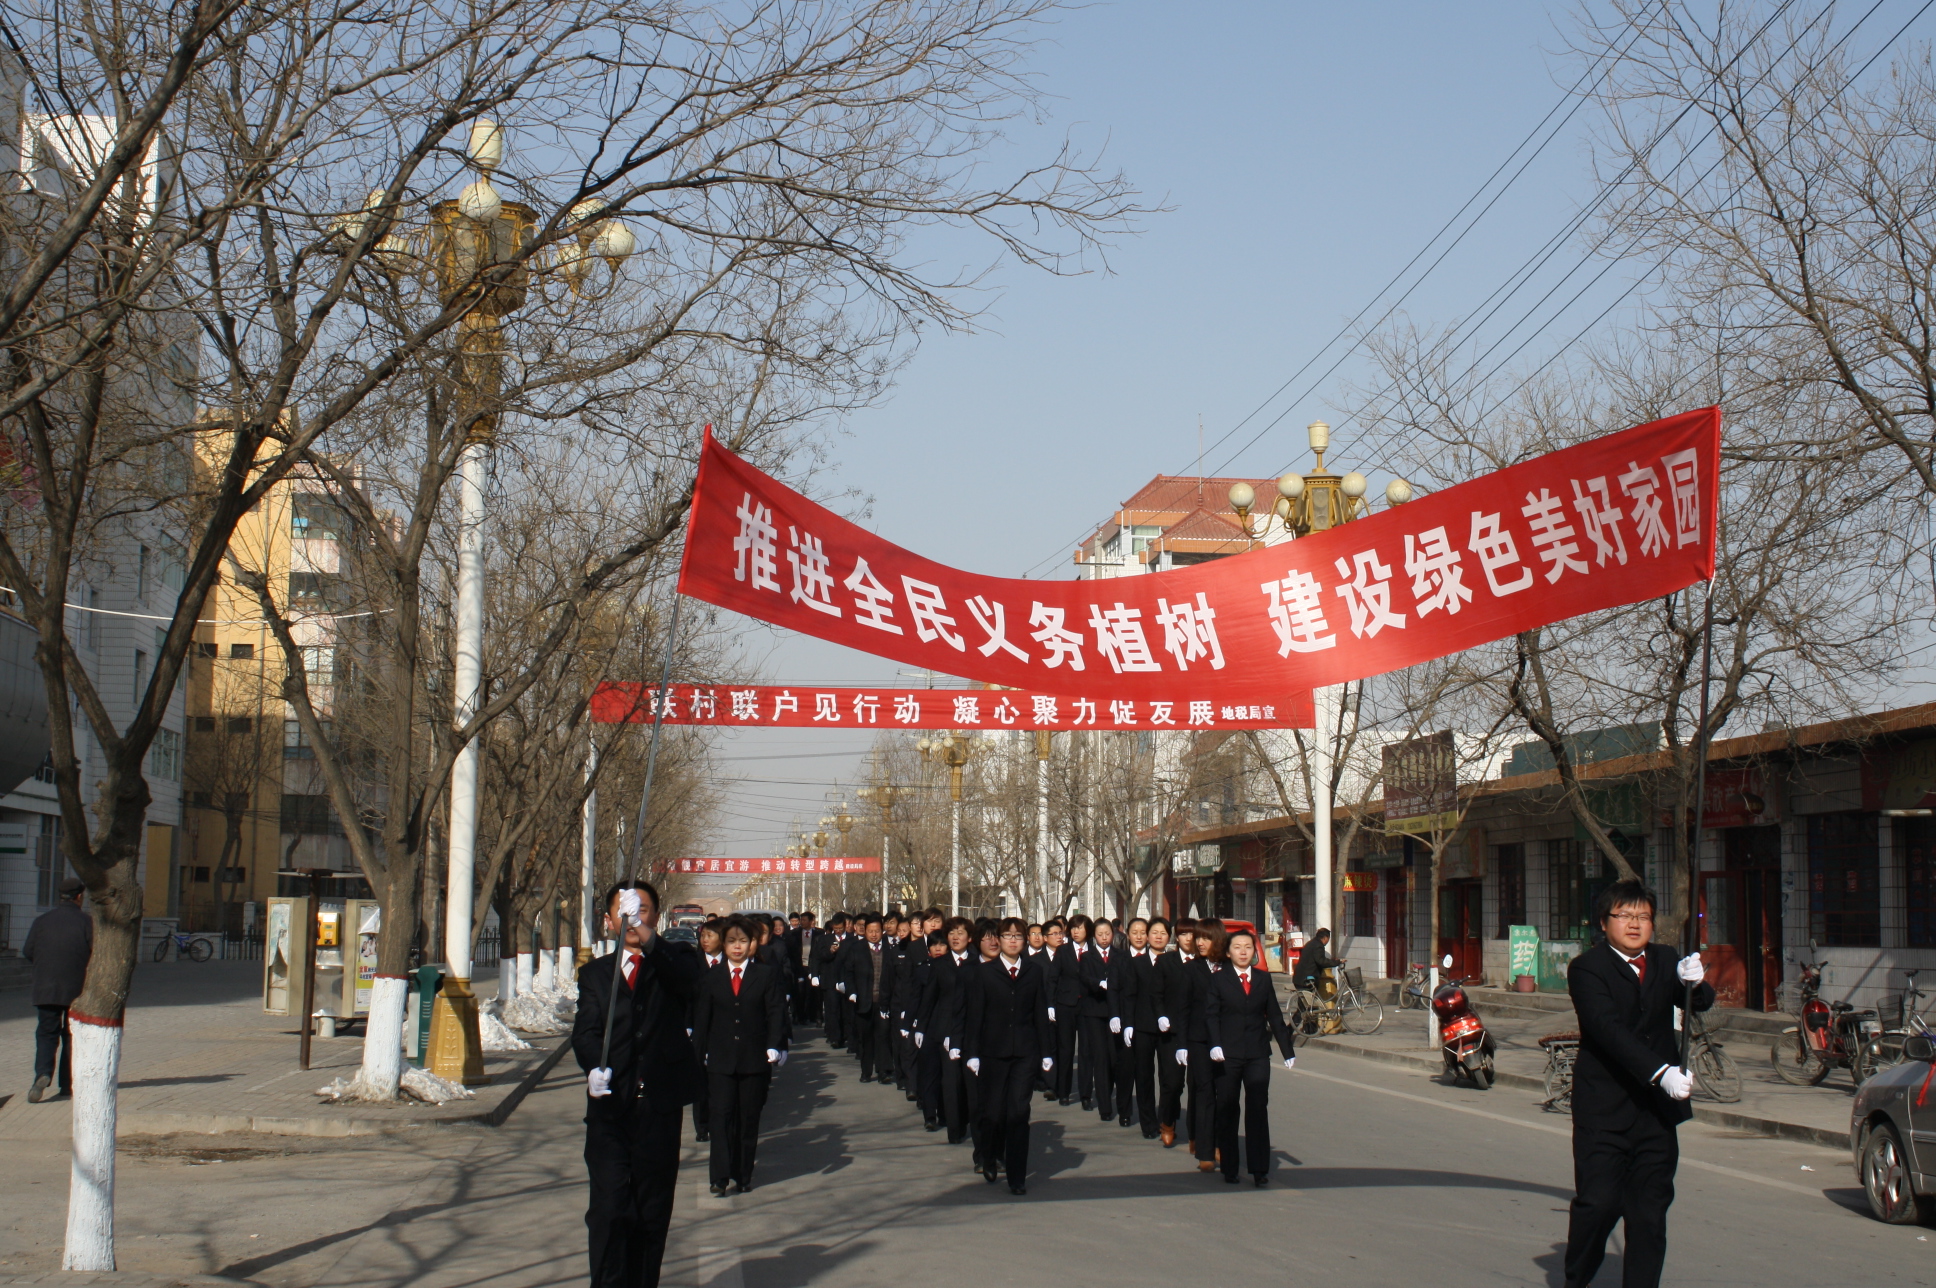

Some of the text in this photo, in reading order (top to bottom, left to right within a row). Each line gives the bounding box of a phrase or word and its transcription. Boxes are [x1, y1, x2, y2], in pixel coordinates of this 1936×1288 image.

[733, 446, 1702, 675] 推进全民义务植树 建设绿色美好家园
[647, 688, 921, 724] 联村联户见行动
[1221, 704, 1276, 720] 地税局宣
[760, 858, 845, 873] 推动转型跨越
